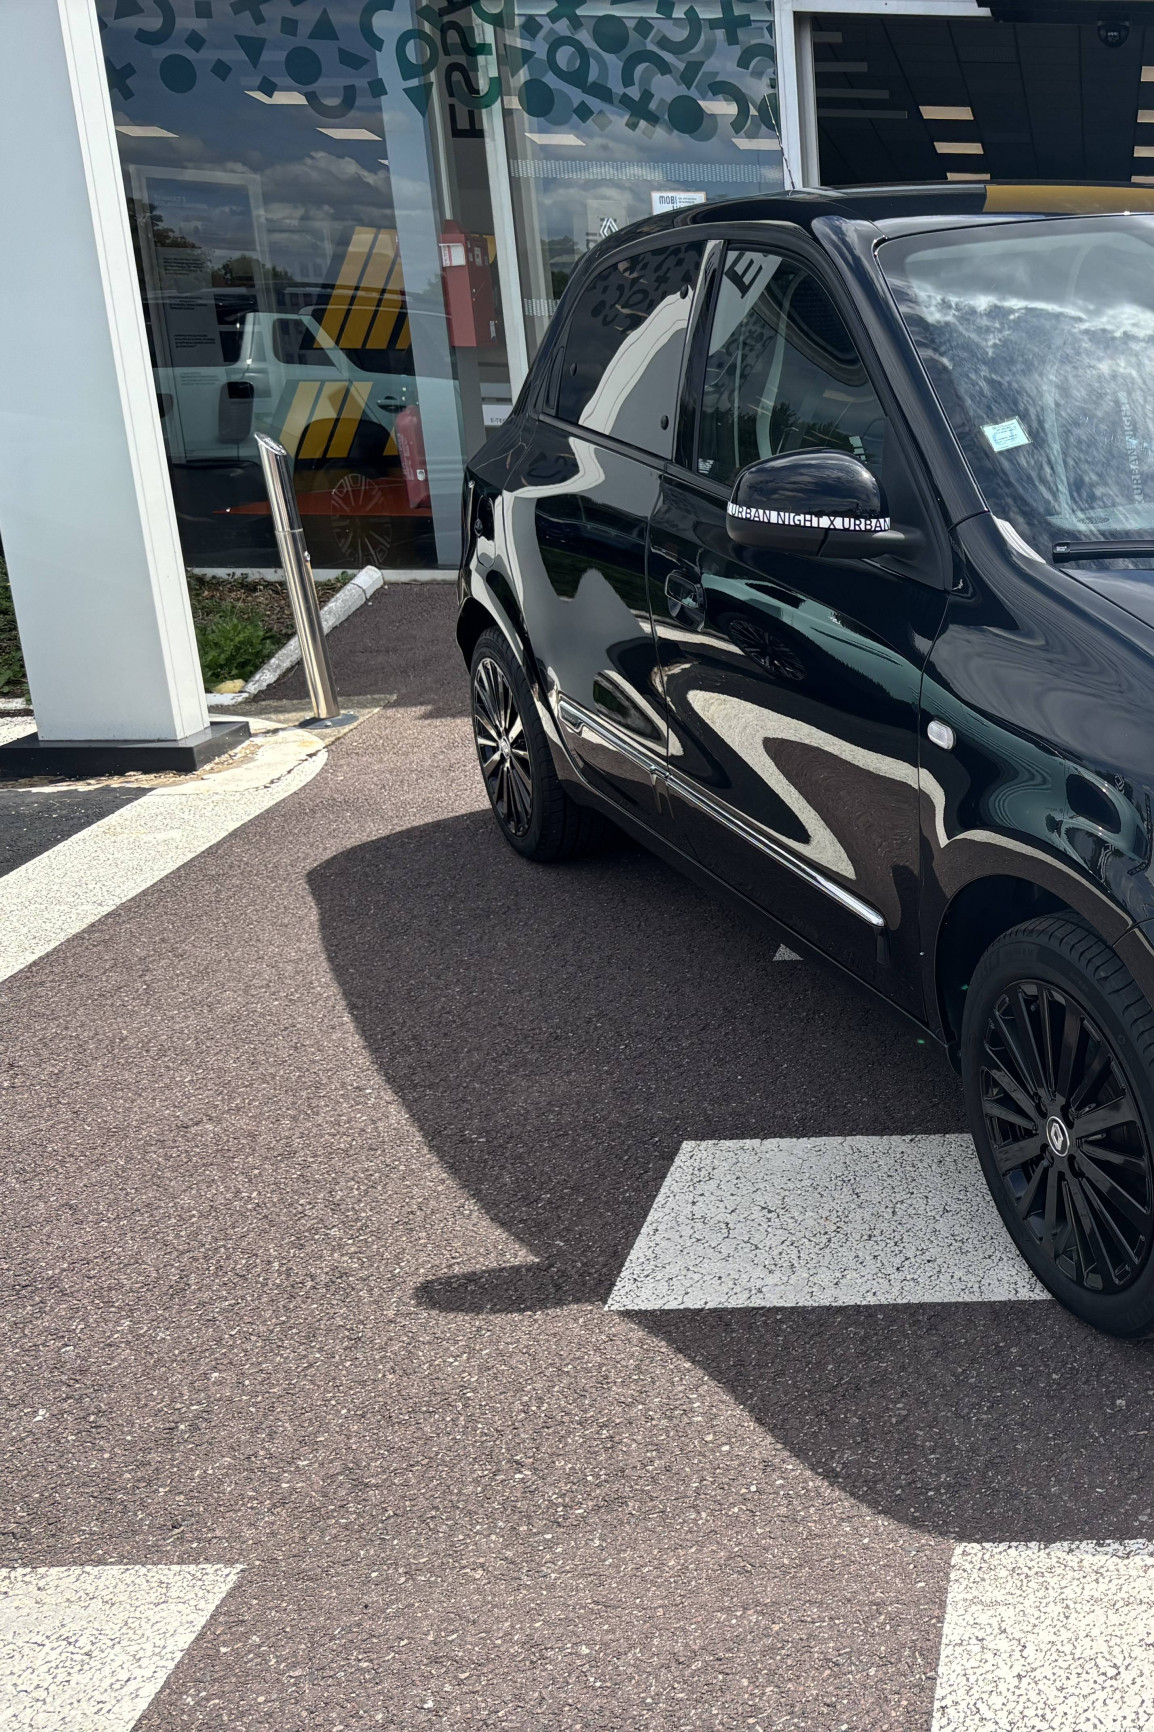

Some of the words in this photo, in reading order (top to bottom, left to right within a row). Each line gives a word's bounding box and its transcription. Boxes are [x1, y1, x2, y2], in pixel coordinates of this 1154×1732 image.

[731, 504, 771, 523] URBAN
[777, 512, 823, 528] NIGHT
[829, 516, 839, 529] X
